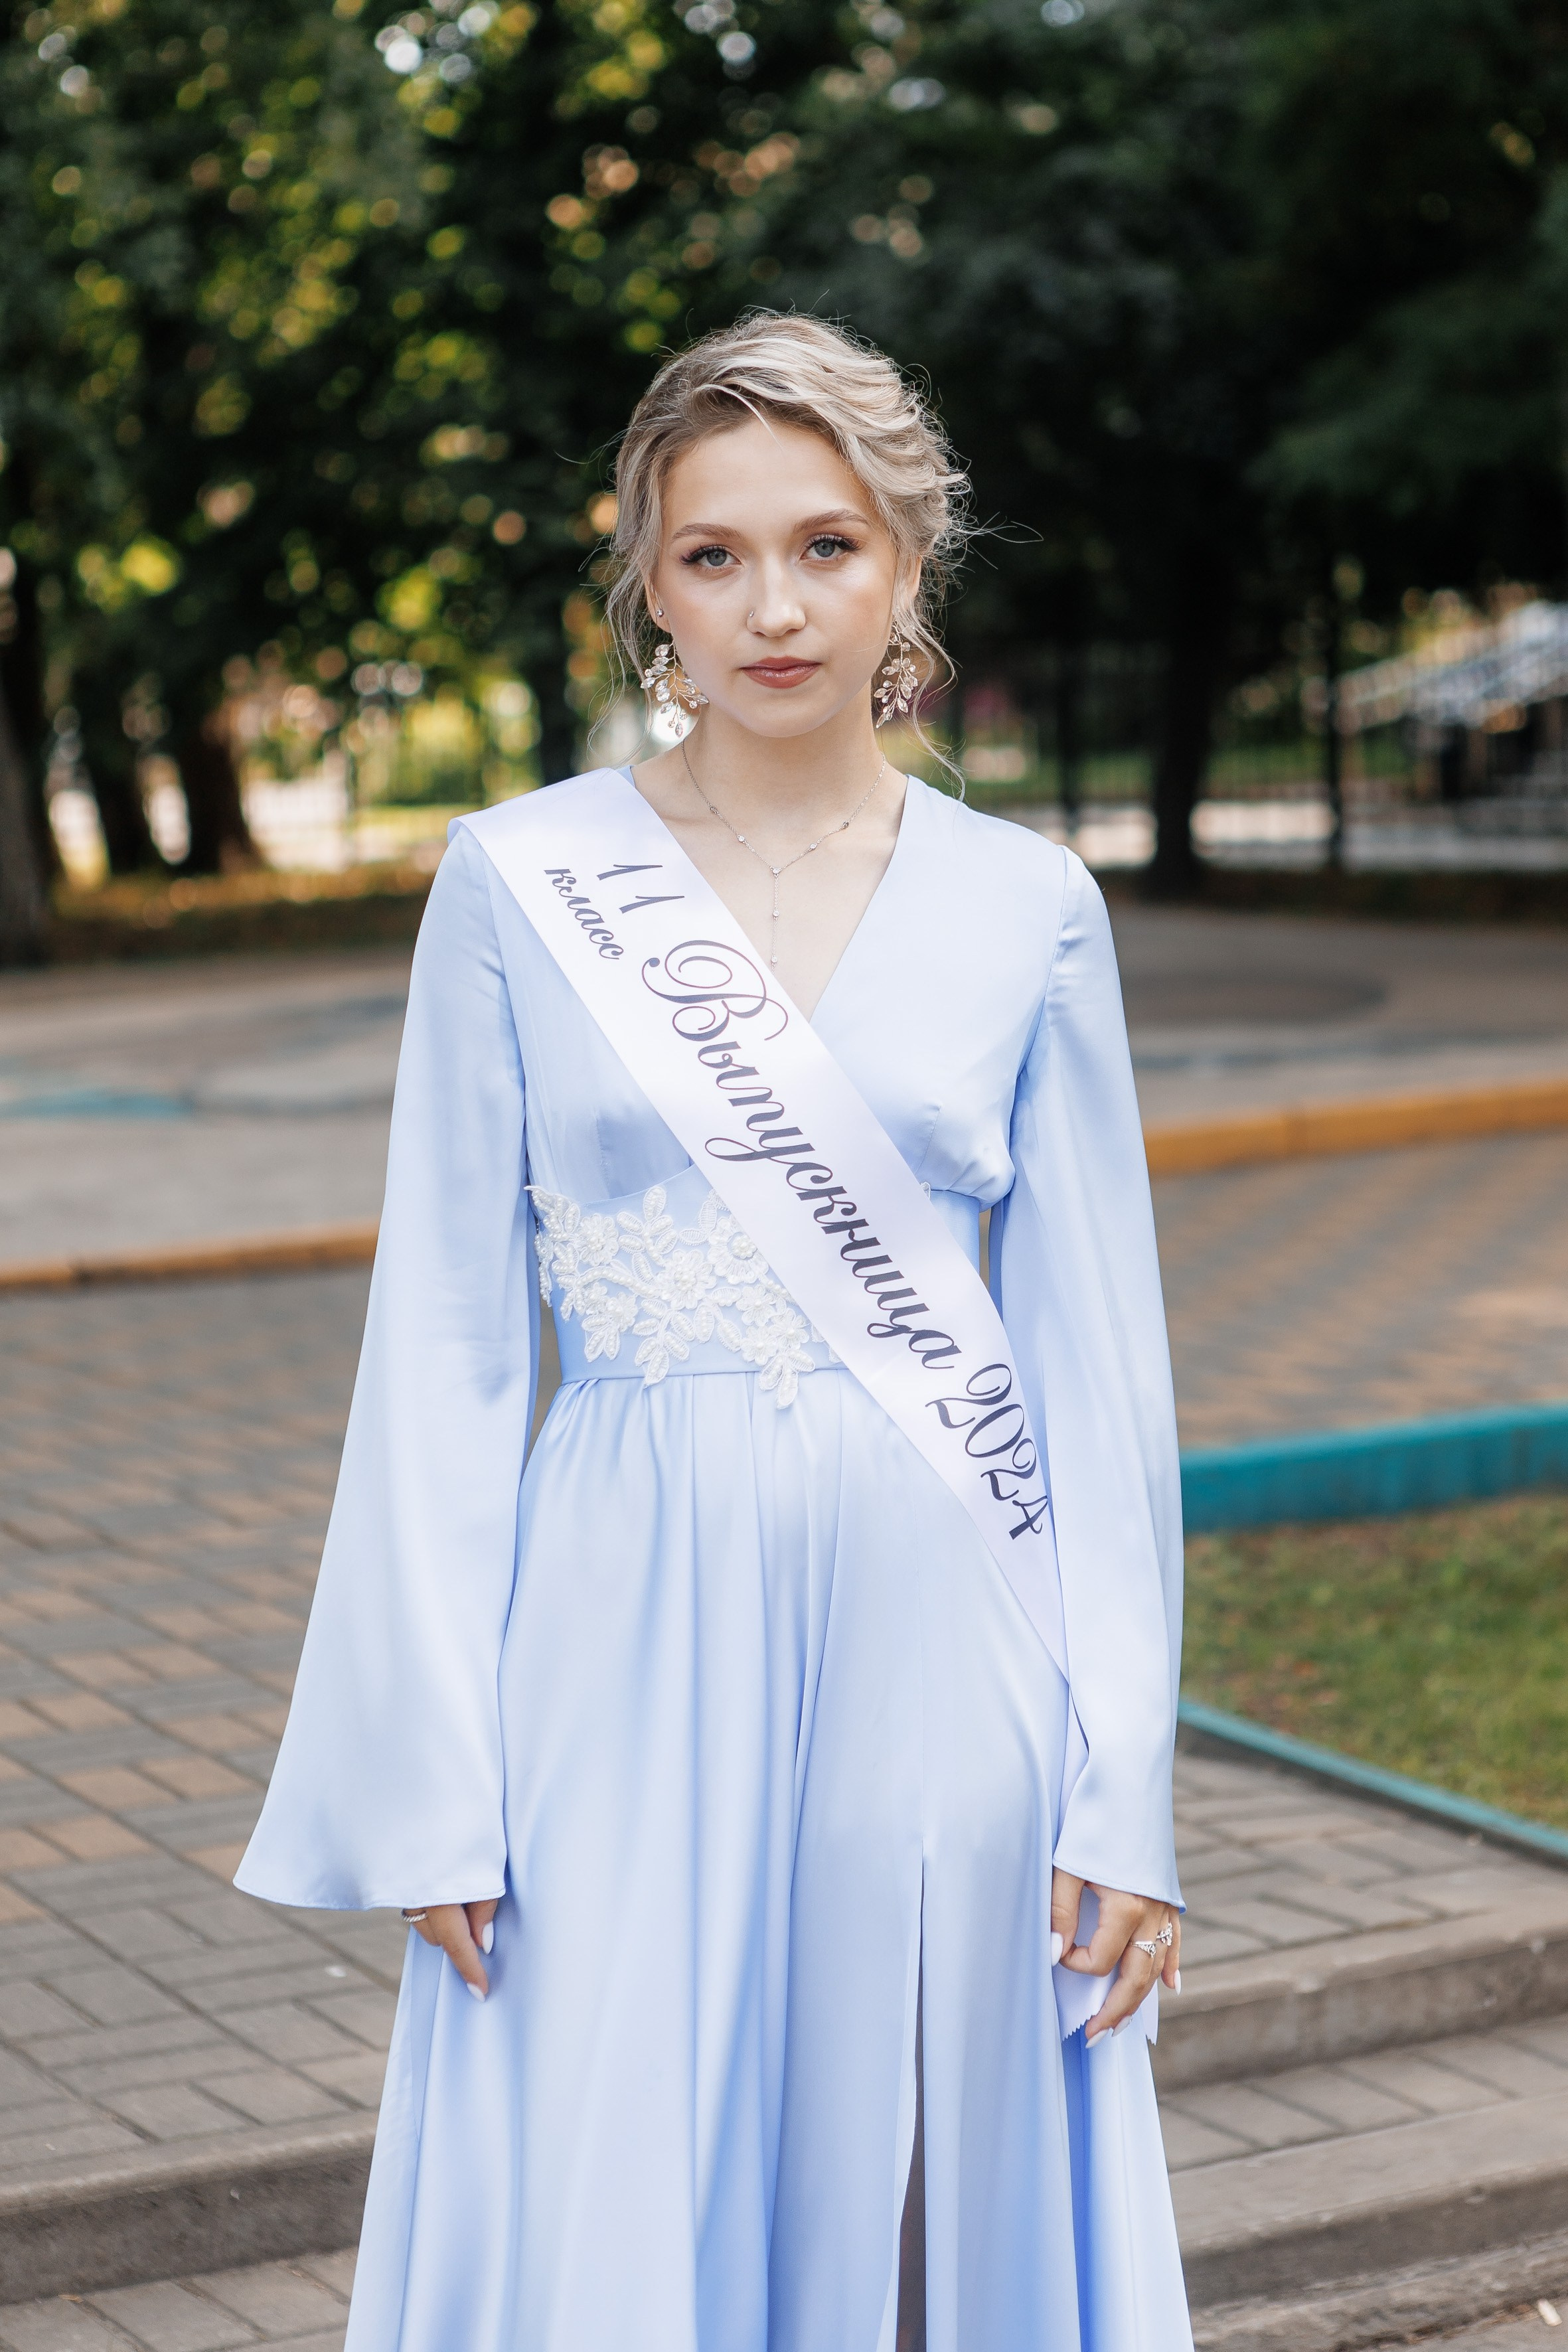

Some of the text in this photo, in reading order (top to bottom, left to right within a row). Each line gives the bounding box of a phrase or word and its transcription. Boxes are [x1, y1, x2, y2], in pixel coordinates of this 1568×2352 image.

[544, 868, 624, 960] класс
[596, 864, 685, 914] 11
[641, 939, 1049, 1540] Выпускница 2024
